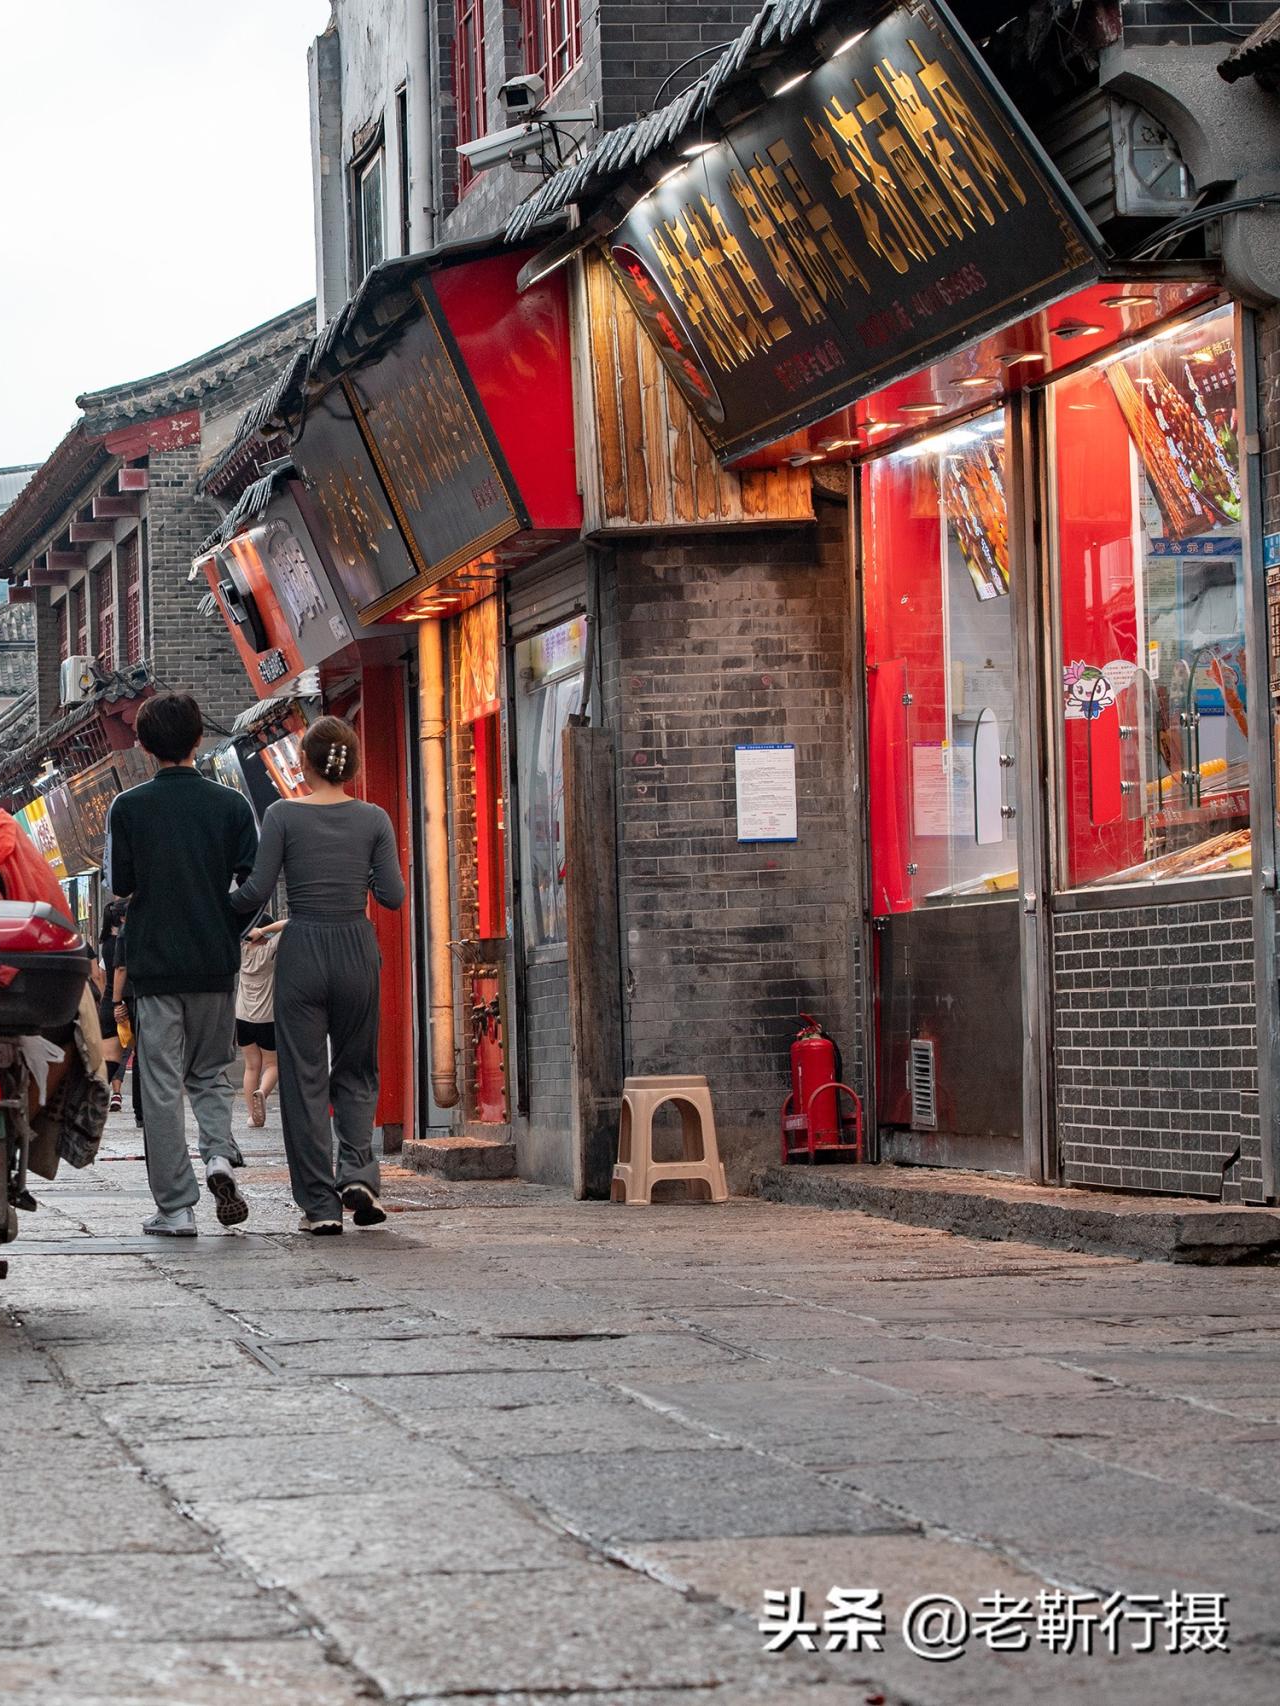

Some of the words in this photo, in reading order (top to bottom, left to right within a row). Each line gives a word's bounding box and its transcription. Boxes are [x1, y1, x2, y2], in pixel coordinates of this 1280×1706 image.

[649, 192, 793, 374] 铁板鱿鱼
[803, 38, 1026, 275] 老济南烤肉
